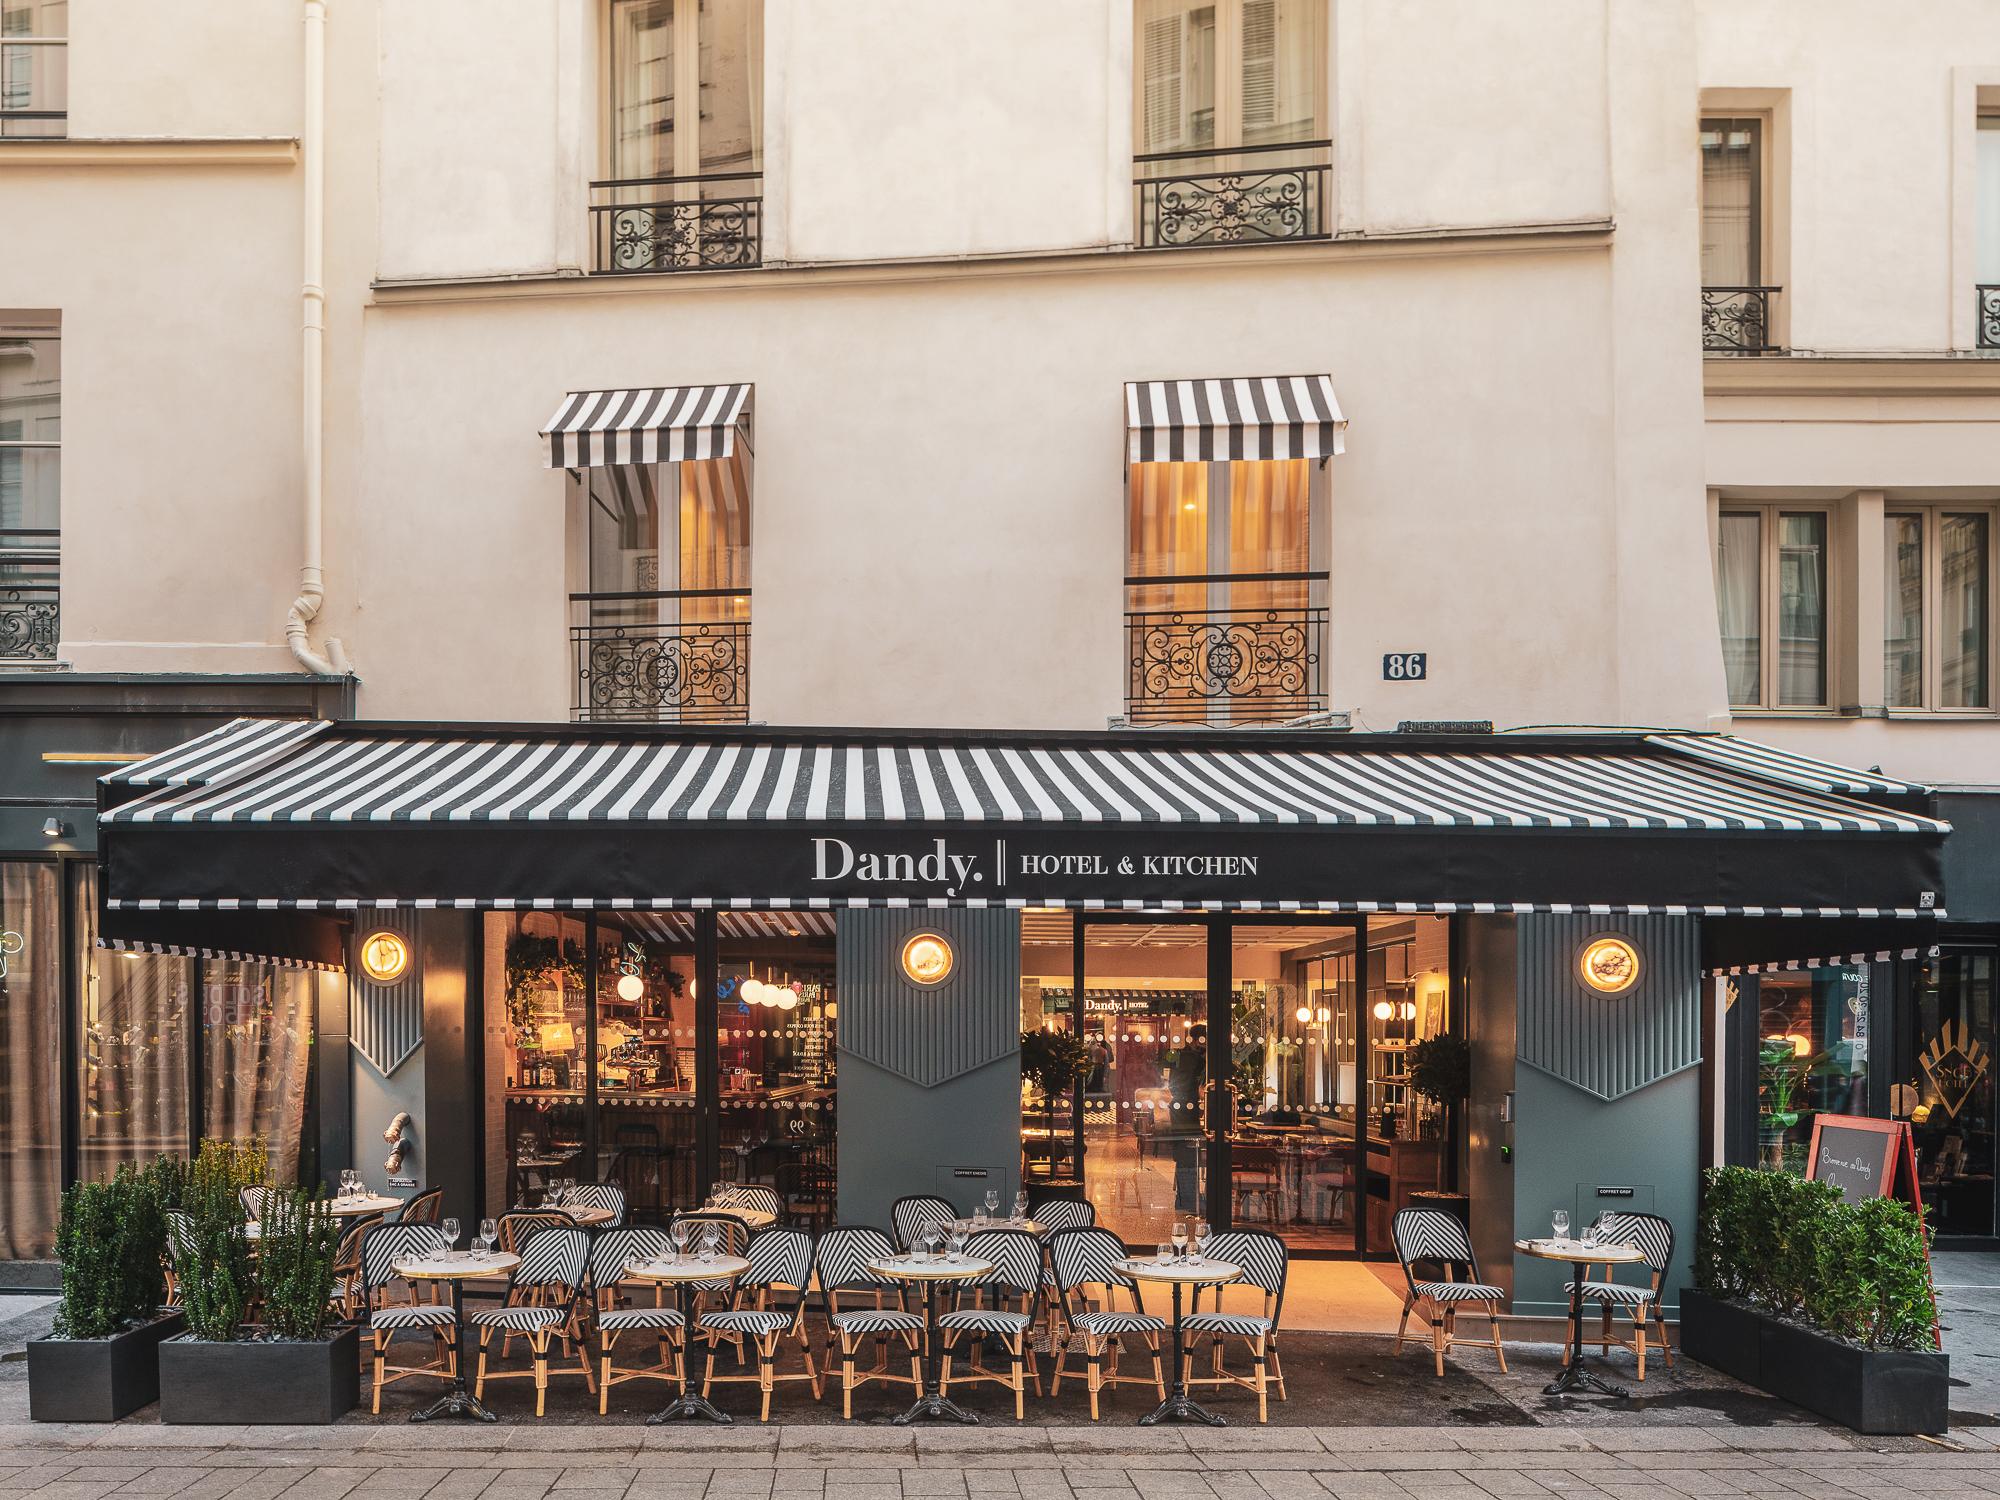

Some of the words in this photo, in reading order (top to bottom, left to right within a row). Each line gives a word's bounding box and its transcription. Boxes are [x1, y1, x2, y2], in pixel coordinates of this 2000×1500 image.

[1388, 654, 1421, 678] 86
[810, 838, 983, 897] Dandy.
[1020, 855, 1109, 875] HOTEL
[1117, 856, 1136, 876] &
[1142, 856, 1259, 877] KITCHEN
